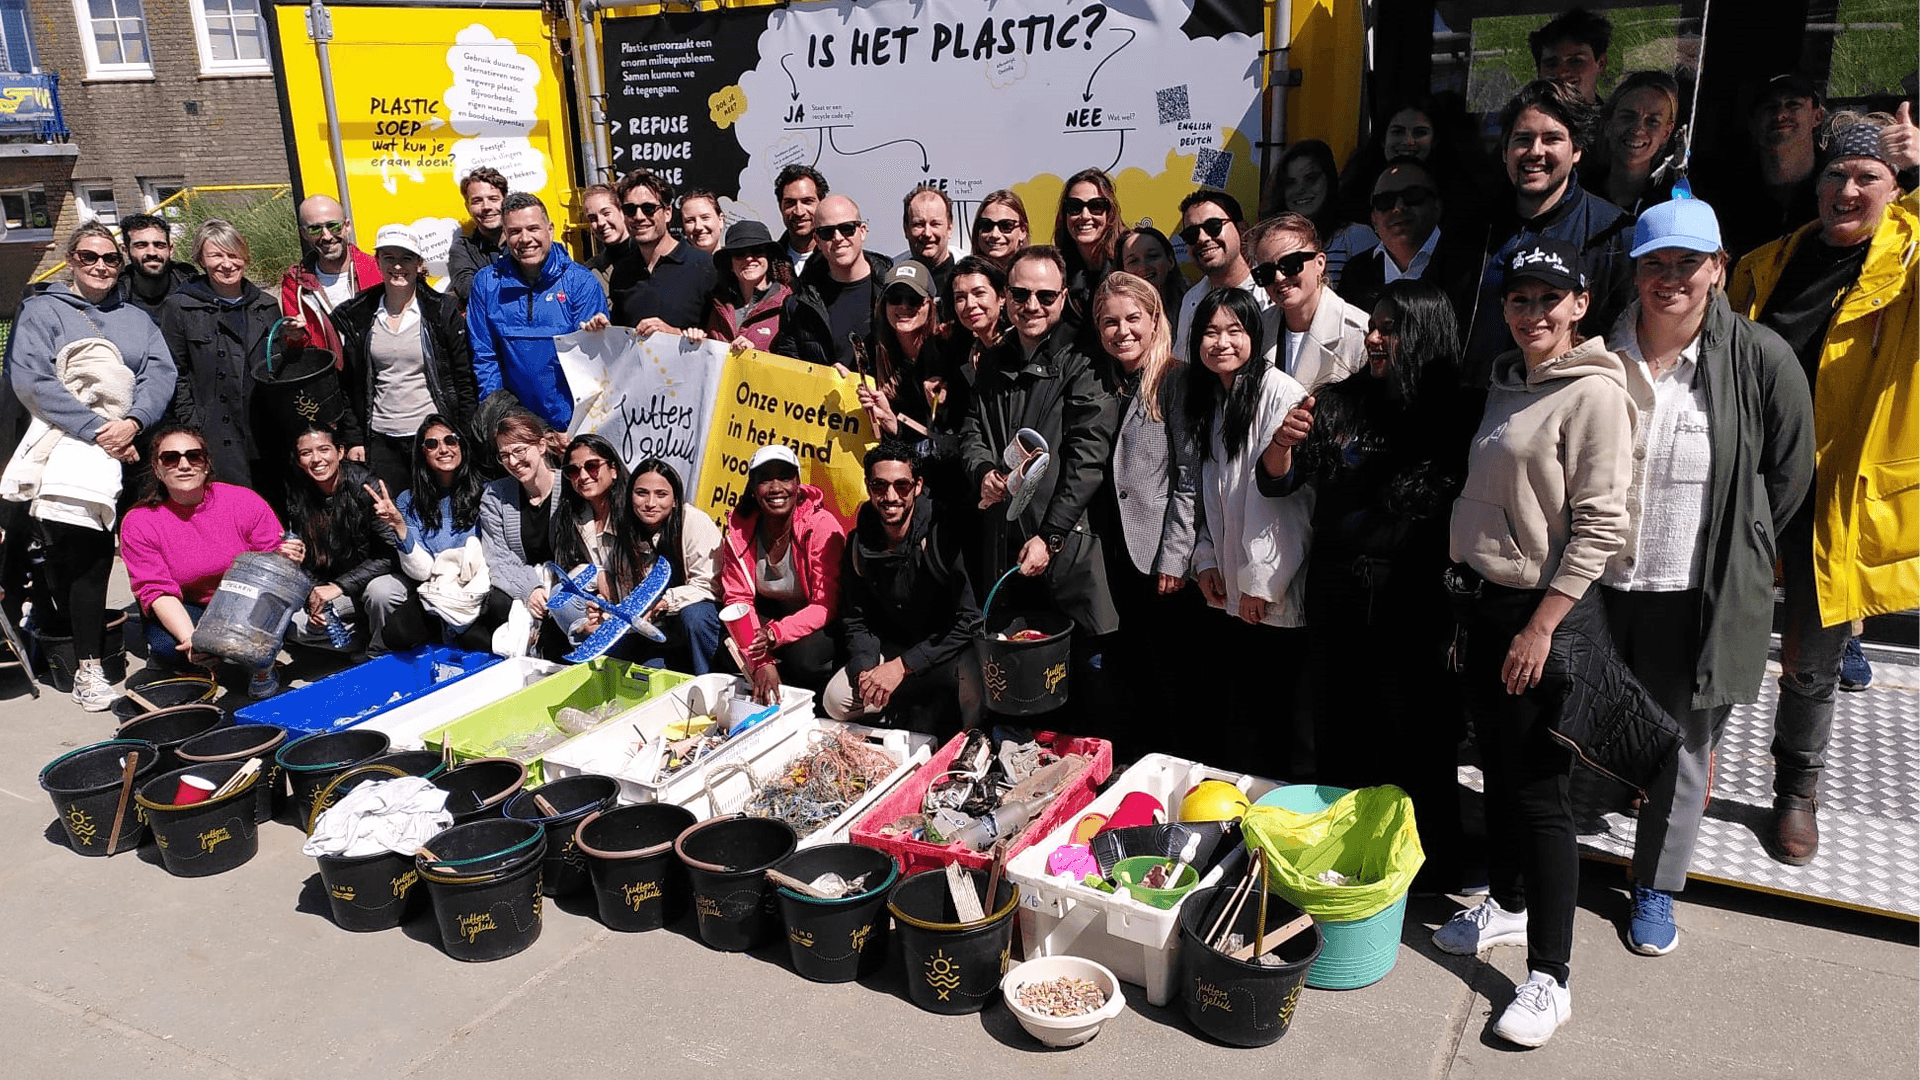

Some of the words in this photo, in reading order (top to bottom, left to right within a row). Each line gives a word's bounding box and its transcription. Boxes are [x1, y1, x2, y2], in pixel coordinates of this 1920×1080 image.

[808, 34, 834, 68] IS
[851, 26, 919, 66] HET
[931, 3, 1107, 62] PLASTIC?
[621, 42, 648, 54] Plastic
[649, 38, 694, 52] veroorzaakt
[696, 40, 712, 48] een
[463, 52, 492, 65] Gebruik
[621, 59, 647, 68] enorm
[649, 52, 715, 68] milieuprobleem.
[463, 64, 508, 80] alternatieven
[622, 70, 649, 82] Samen
[651, 69, 681, 80] kunnen
[683, 71, 695, 79] we
[471, 88, 515, 104] Bijvoorbeeld:
[623, 84, 634, 96] dit
[636, 85, 680, 99] tegengaan.
[370, 96, 440, 116] PLASTIC
[467, 99, 486, 110] eigen
[783, 103, 806, 123] JA
[1065, 108, 1103, 128] NEE
[1107, 113, 1120, 121] Wat
[1121, 112, 1136, 121] wel?
[374, 120, 422, 137] SOEP
[629, 115, 689, 136] REFUSE
[1177, 121, 1212, 131] ENGLISH
[403, 137, 427, 152] kun
[430, 138, 445, 157] je
[480, 140, 506, 152] Feestje?
[1180, 136, 1212, 147] DEUTCH
[631, 141, 693, 162] REDUCE
[371, 157, 411, 168] eraan
[416, 153, 457, 168] doen?
[424, 231, 437, 239] een
[430, 238, 449, 249] event
[736, 381, 778, 414] Onze
[783, 399, 861, 435] voeten
[614, 394, 693, 465] Jutters
[727, 414, 743, 438] in
[747, 418, 776, 448] het
[781, 436, 833, 465] zand
[621, 880, 656, 906] Jutters
[632, 886, 663, 912] geluk
[456, 912, 491, 938] Jutters
[467, 918, 498, 944] geluk
